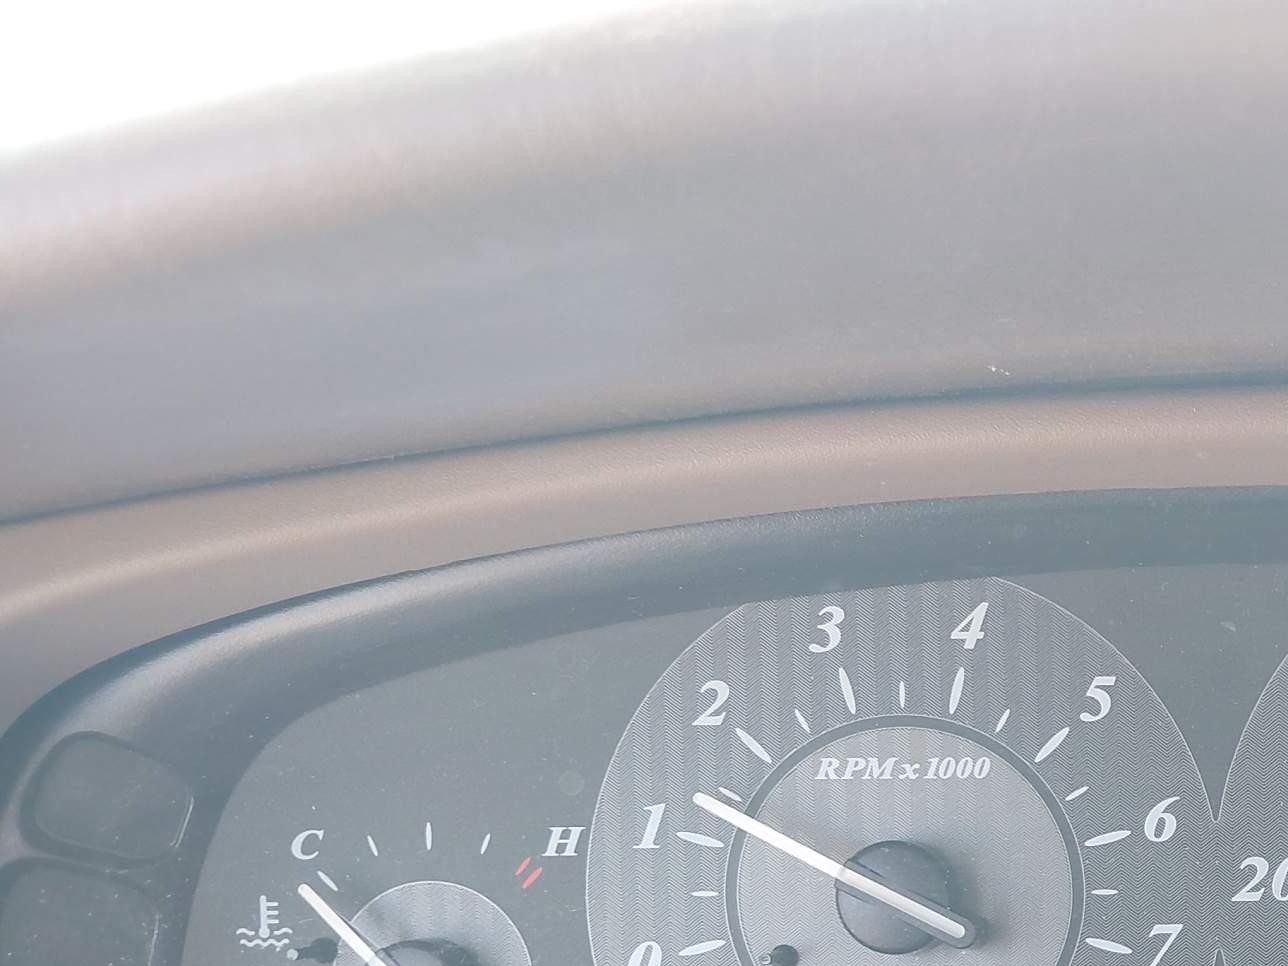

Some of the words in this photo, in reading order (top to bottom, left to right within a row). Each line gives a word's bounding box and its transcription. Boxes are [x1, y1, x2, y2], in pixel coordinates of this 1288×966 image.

[808, 605, 845, 653] 3
[950, 601, 989, 650] 4
[692, 680, 730, 726] 2
[1079, 675, 1116, 722] 5
[815, 757, 898, 780] RPM
[898, 763, 920, 780] x
[923, 756, 991, 779] 1000
[542, 826, 585, 857] H
[633, 803, 666, 849] 1
[1143, 796, 1180, 843] 6
[290, 829, 324, 861] C
